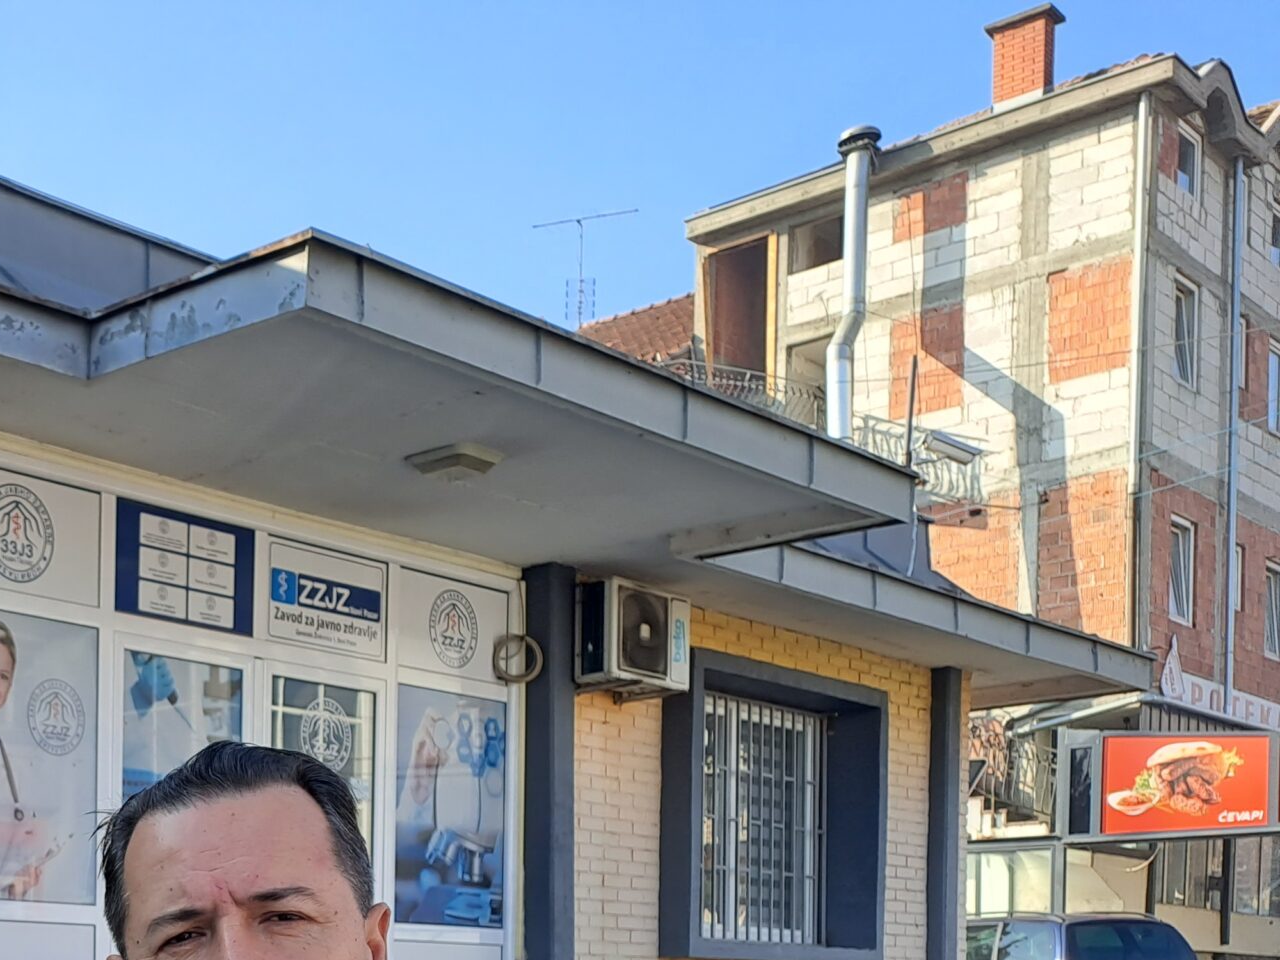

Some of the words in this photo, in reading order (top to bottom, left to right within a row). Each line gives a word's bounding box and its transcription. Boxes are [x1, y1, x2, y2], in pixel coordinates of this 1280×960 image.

[299, 578, 350, 612] ZZJZ
[274, 606, 303, 627] Zavod
[304, 615, 315, 626] za
[316, 615, 342, 631] javno
[343, 619, 378, 642] zdravlje
[673, 618, 686, 664] beko
[1170, 681, 1280, 731] POTEK
